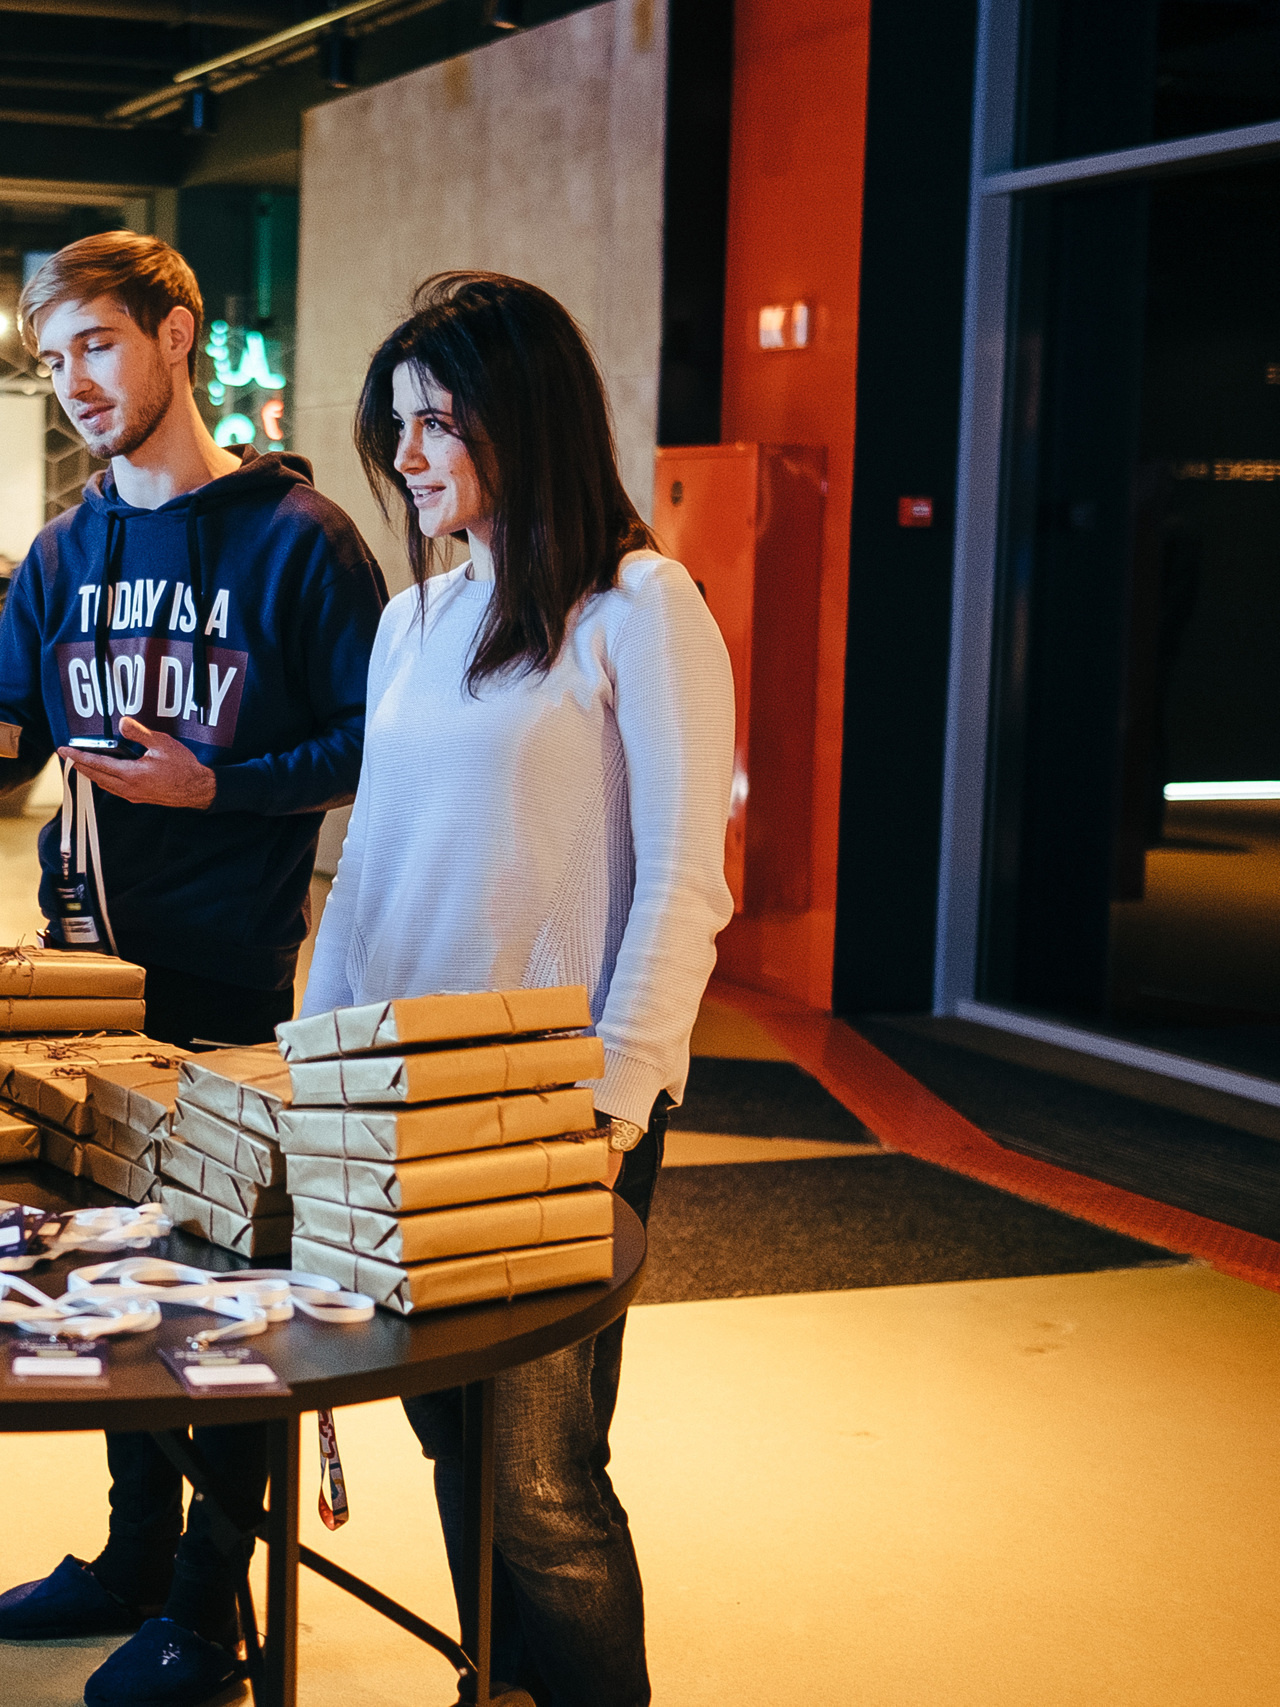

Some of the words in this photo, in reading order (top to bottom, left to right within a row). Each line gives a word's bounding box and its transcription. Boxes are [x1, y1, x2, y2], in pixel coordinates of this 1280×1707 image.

[169, 582, 197, 633] IS
[204, 588, 230, 638] A
[68, 654, 145, 718] GOOD
